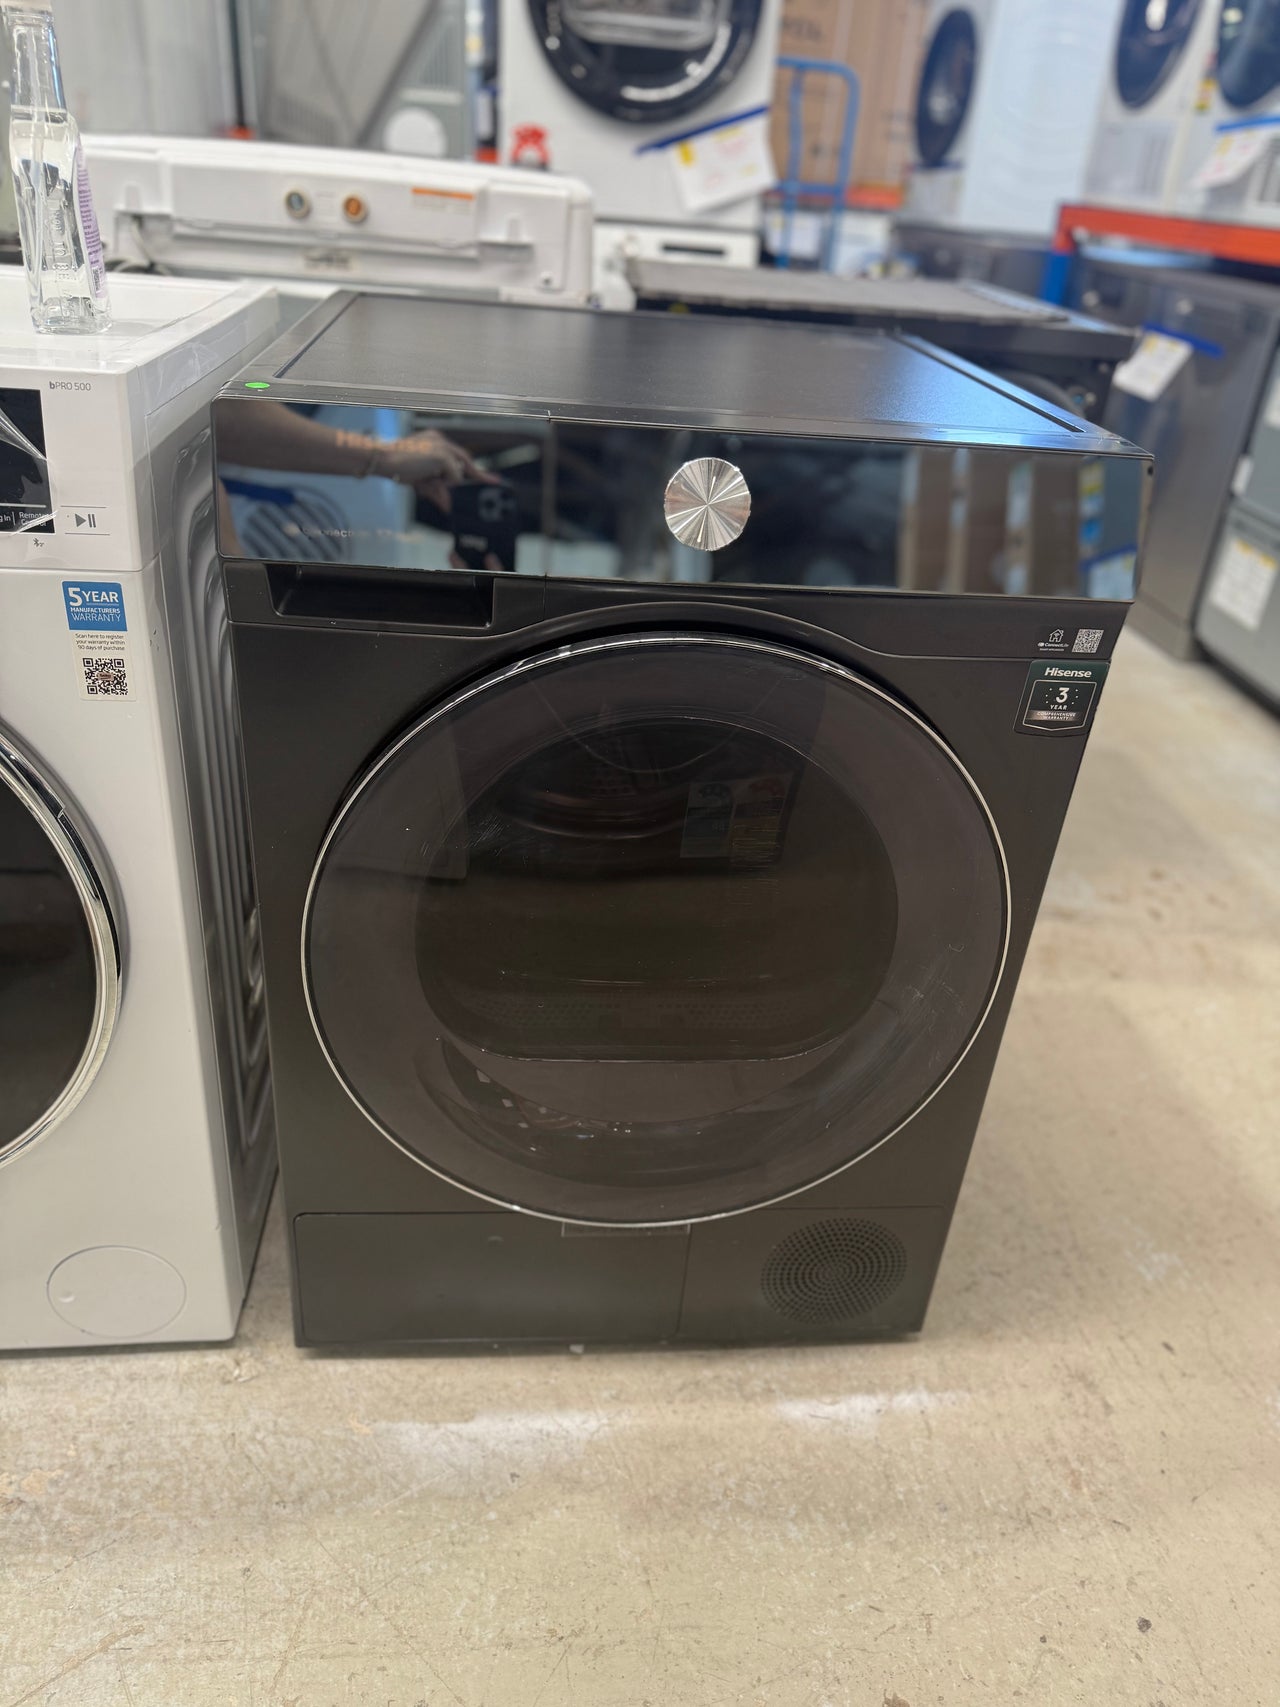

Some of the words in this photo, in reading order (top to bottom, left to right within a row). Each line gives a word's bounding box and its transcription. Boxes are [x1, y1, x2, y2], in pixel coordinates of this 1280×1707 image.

[49, 381, 73, 391] bPRO
[74, 382, 91, 391] 500
[68, 587, 83, 607] 5
[81, 591, 119, 603] YEAR
[71, 613, 121, 622] WARRANTY
[1044, 667, 1092, 678] Hisense
[1055, 687, 1070, 703] 3
